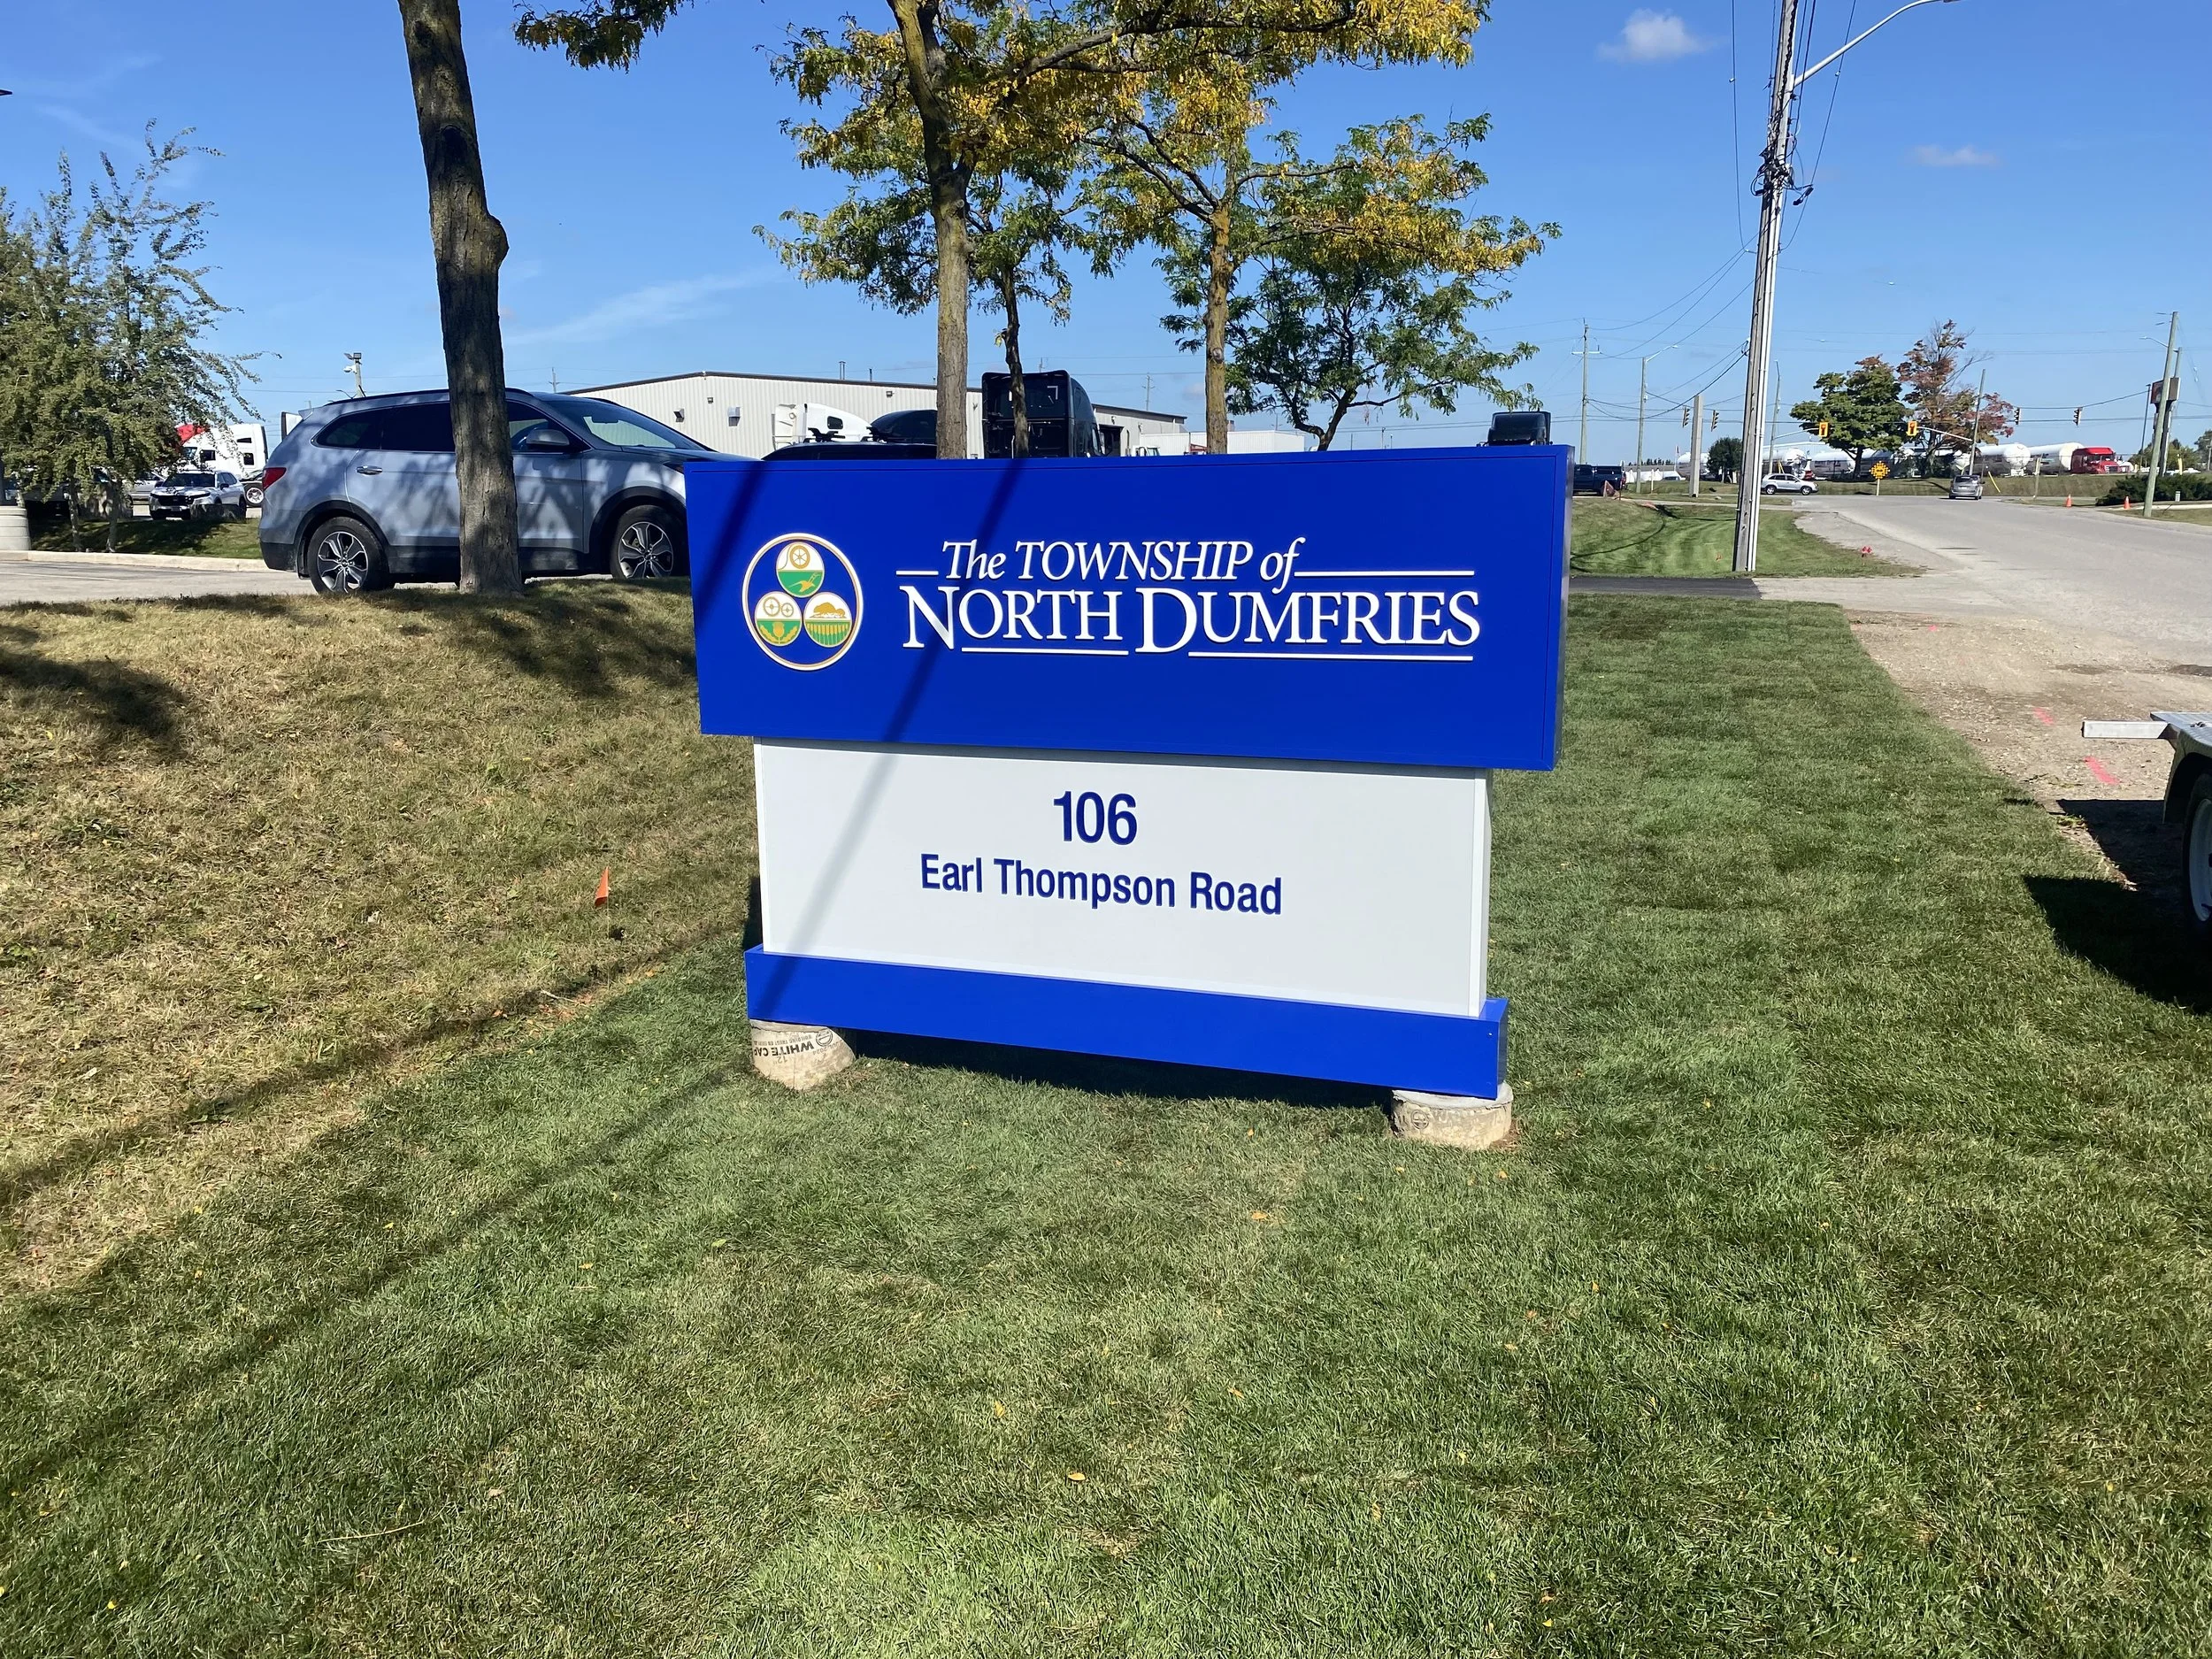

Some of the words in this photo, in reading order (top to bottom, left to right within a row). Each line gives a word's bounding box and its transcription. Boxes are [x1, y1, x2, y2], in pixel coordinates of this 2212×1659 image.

[941, 539, 1006, 580] The
[1015, 541, 1254, 580] TOWNSHIP
[1260, 536, 1305, 594] of
[899, 586, 1124, 649] NORTH
[1135, 588, 1480, 654] DUMFRIES
[1053, 790, 1138, 845] 106
[920, 853, 982, 893] Earl
[993, 857, 1175, 910] Thompson
[1189, 871, 1282, 915] Road
[771, 1041, 814, 1056] WHITE
